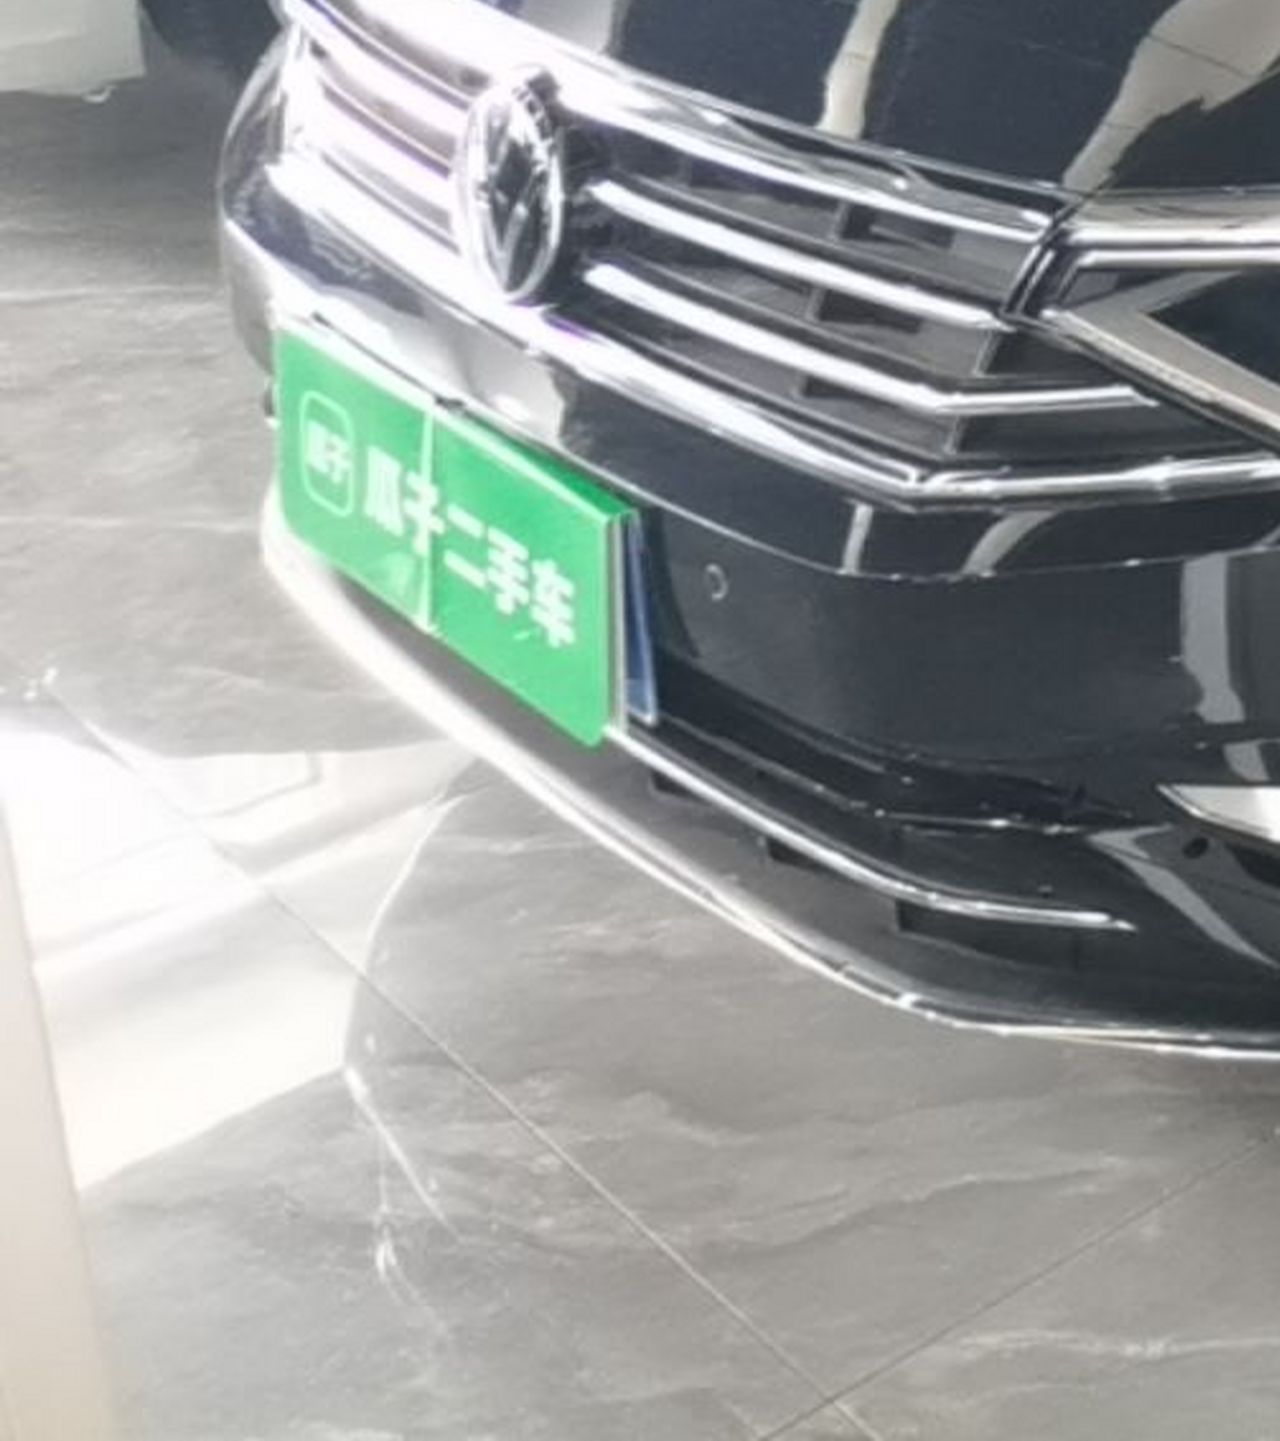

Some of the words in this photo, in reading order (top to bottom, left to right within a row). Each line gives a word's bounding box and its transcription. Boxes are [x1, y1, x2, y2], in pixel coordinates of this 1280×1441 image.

[363, 445, 575, 649] 瓜子二手车
